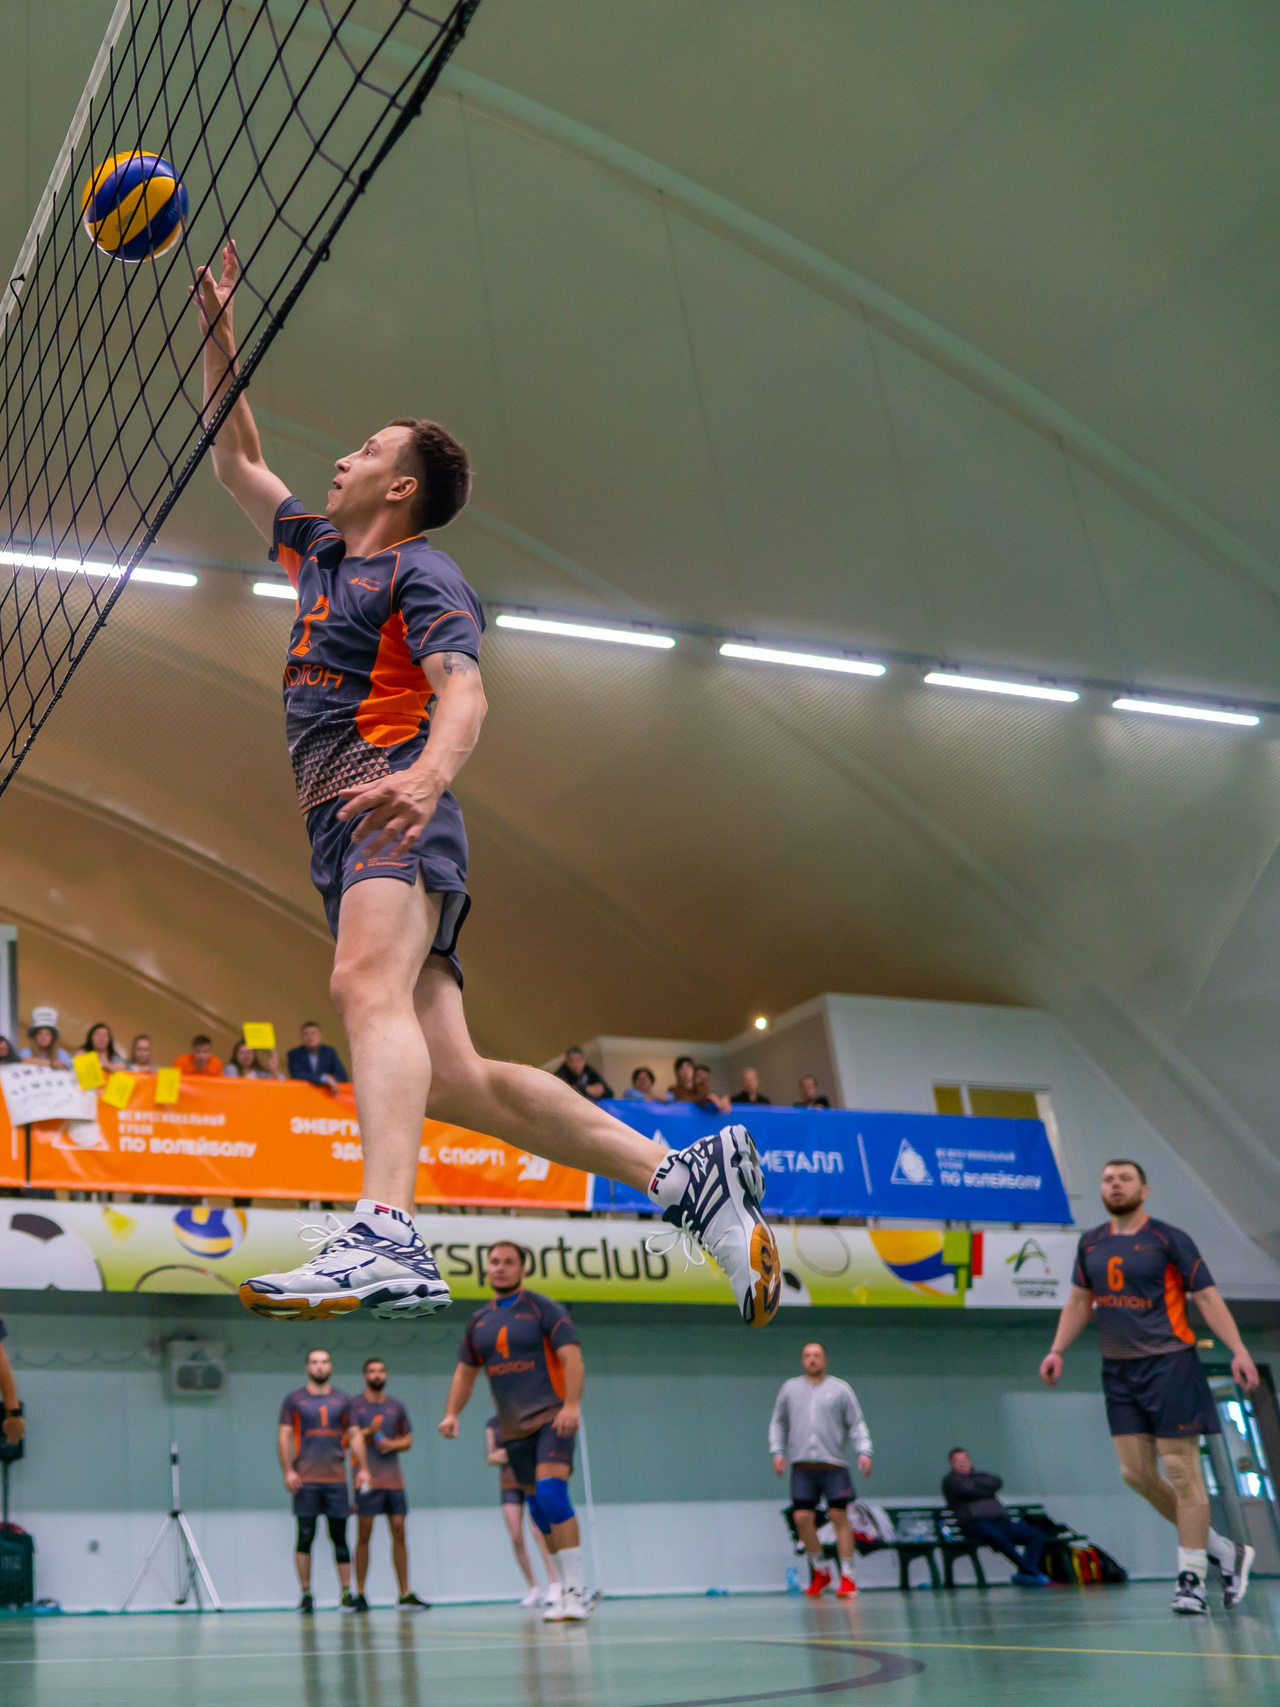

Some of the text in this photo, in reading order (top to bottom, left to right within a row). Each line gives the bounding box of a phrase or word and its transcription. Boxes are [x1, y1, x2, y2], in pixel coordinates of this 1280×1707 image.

[291, 1117, 360, 1136] ЭНЕРГИ
[119, 1136, 257, 1159] ПО ВОЛЕЙБОЛУ
[439, 1147, 505, 1167] СПОРТ!
[1107, 1255, 1125, 1292] 6
[495, 1325, 510, 1359] 4
